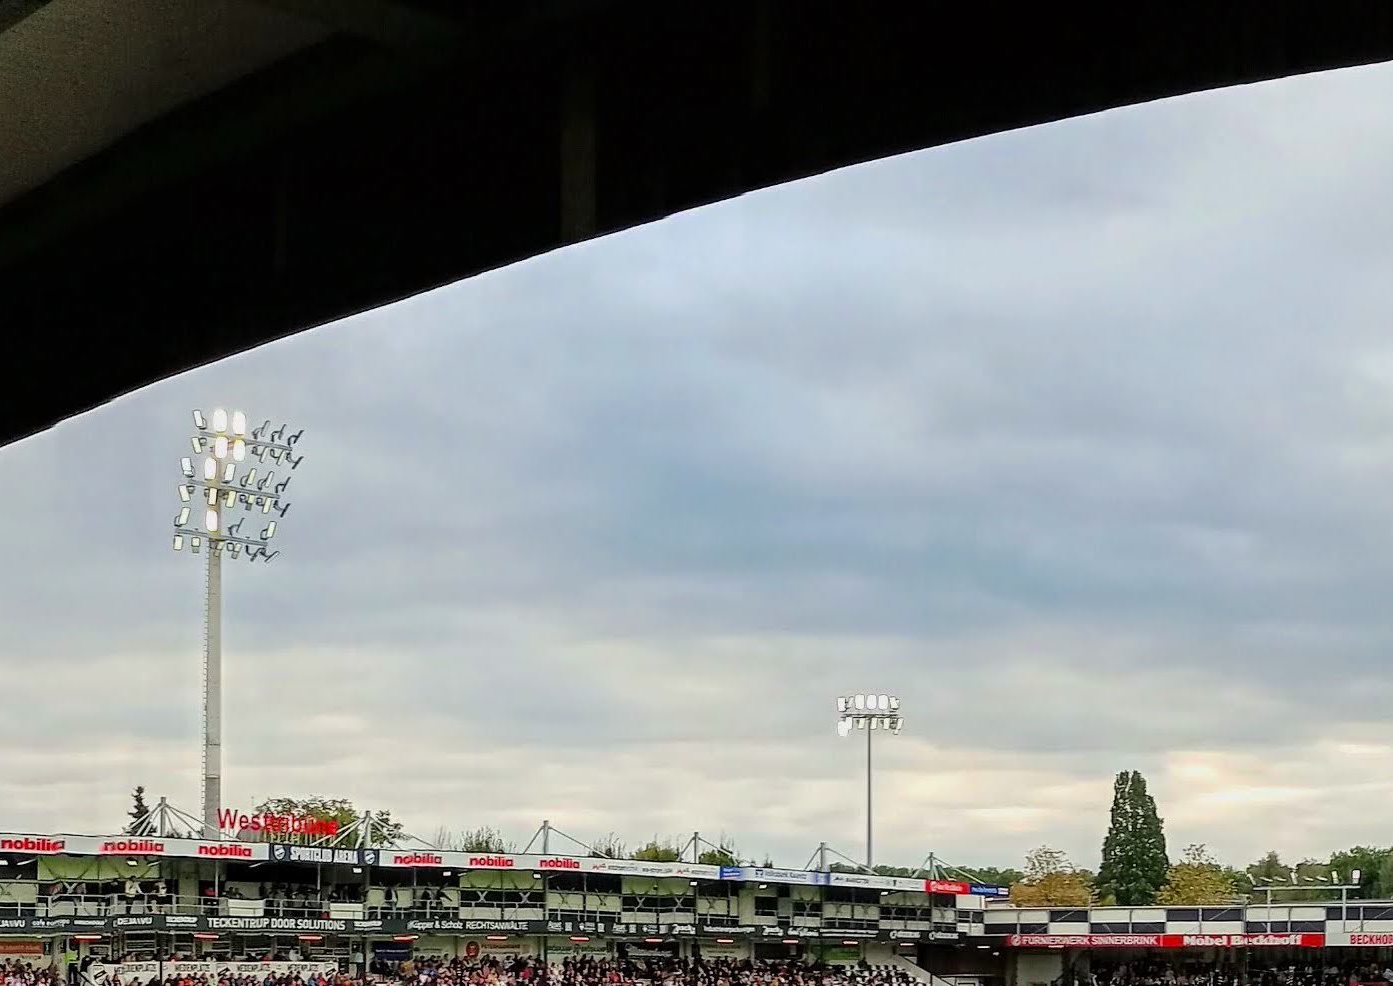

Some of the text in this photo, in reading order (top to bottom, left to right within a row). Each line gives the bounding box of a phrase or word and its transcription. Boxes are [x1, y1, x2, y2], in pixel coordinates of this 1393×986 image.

[1, 838, 65, 852] nobilia
[103, 839, 165, 853] nobilia
[198, 844, 252, 857] nobilia
[394, 853, 442, 865] nobilia
[469, 856, 514, 867] nobilia
[540, 858, 580, 869] nobilia
[206, 917, 269, 929] TECKENTRUP
[270, 917, 296, 929] DOOR
[297, 918, 346, 931] SOLUTIONS
[1182, 934, 1228, 946] Möbel
